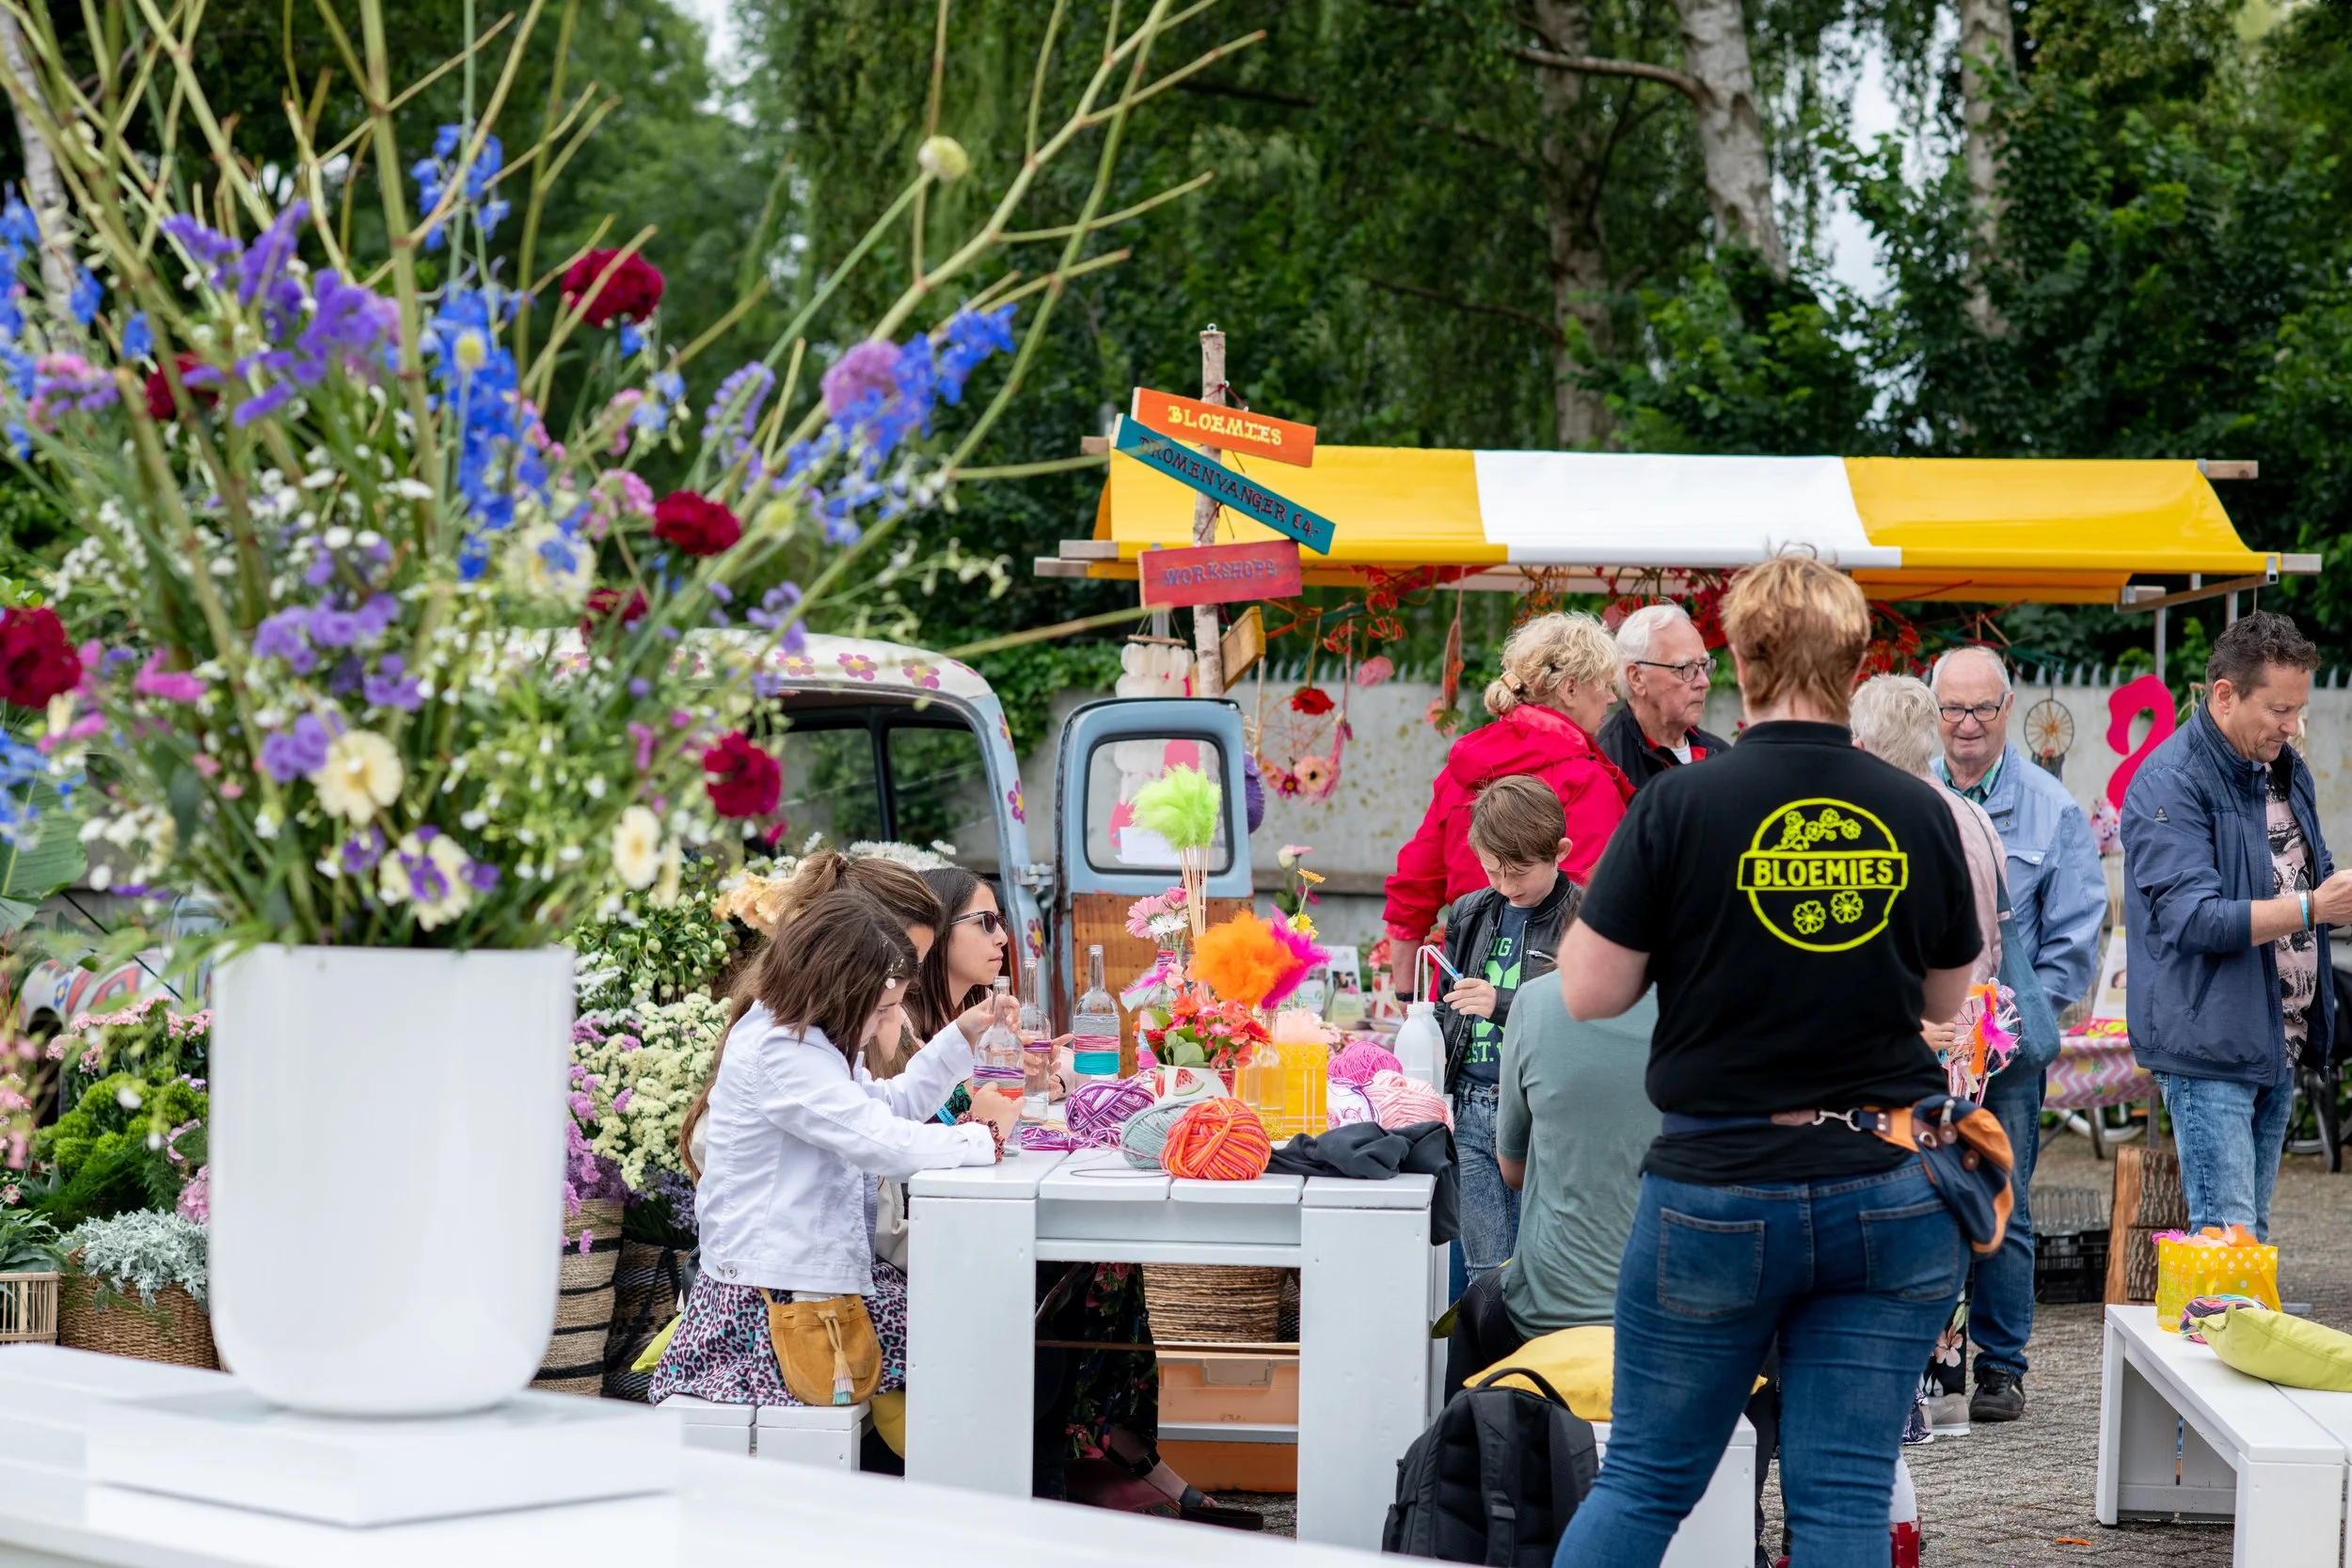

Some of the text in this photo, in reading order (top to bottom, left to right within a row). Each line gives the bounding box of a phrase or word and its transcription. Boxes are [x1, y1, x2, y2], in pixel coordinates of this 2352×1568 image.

[1168, 404, 1282, 446] BLOEMIES
[1139, 436, 1286, 523] DROMENVANGER
[1163, 559, 1277, 587] WORKSHOPS
[1753, 859, 1894, 887] BLOEMIES
